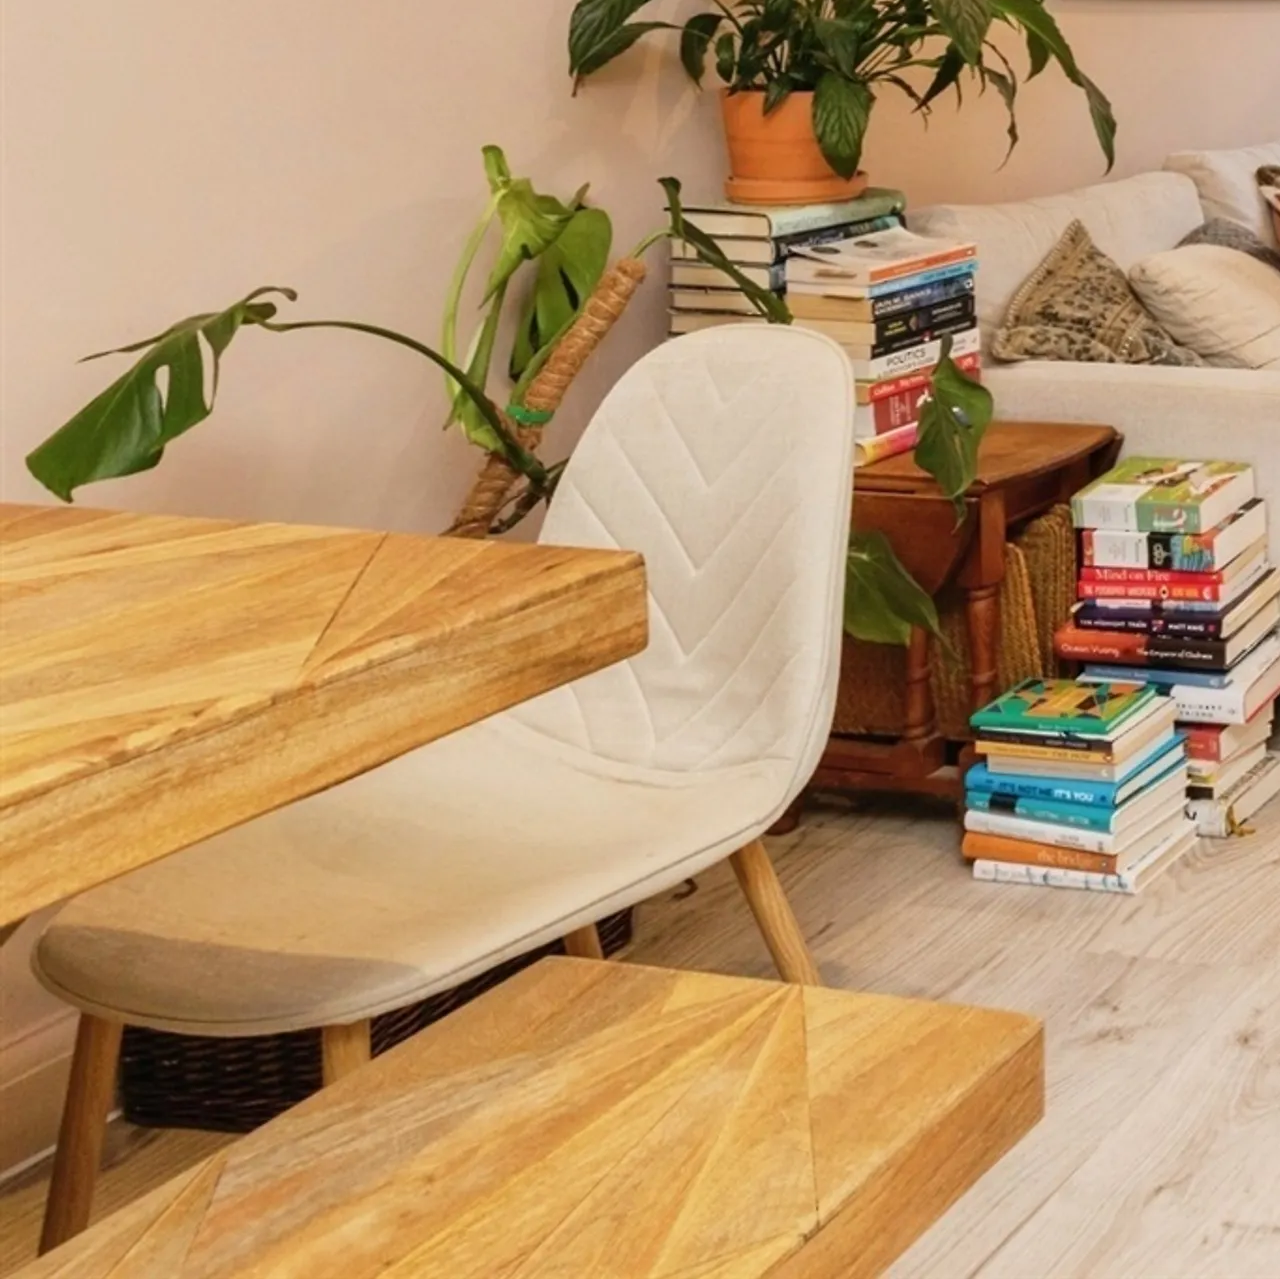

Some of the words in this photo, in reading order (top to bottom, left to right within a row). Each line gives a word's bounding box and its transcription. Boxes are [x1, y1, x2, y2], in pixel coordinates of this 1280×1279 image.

[886, 347, 927, 368] POLITICS
[1094, 568, 1126, 581] Mind
[1129, 572, 1143, 581] on
[1147, 570, 1171, 582] Fire
[1128, 621, 1147, 629] TRAIN
[1061, 642, 1091, 652] Ocean
[1092, 644, 1120, 658] Vuong
[1018, 784, 1037, 796] NOT
[1053, 787, 1072, 800] IT'S
[1073, 790, 1094, 803] YOU
